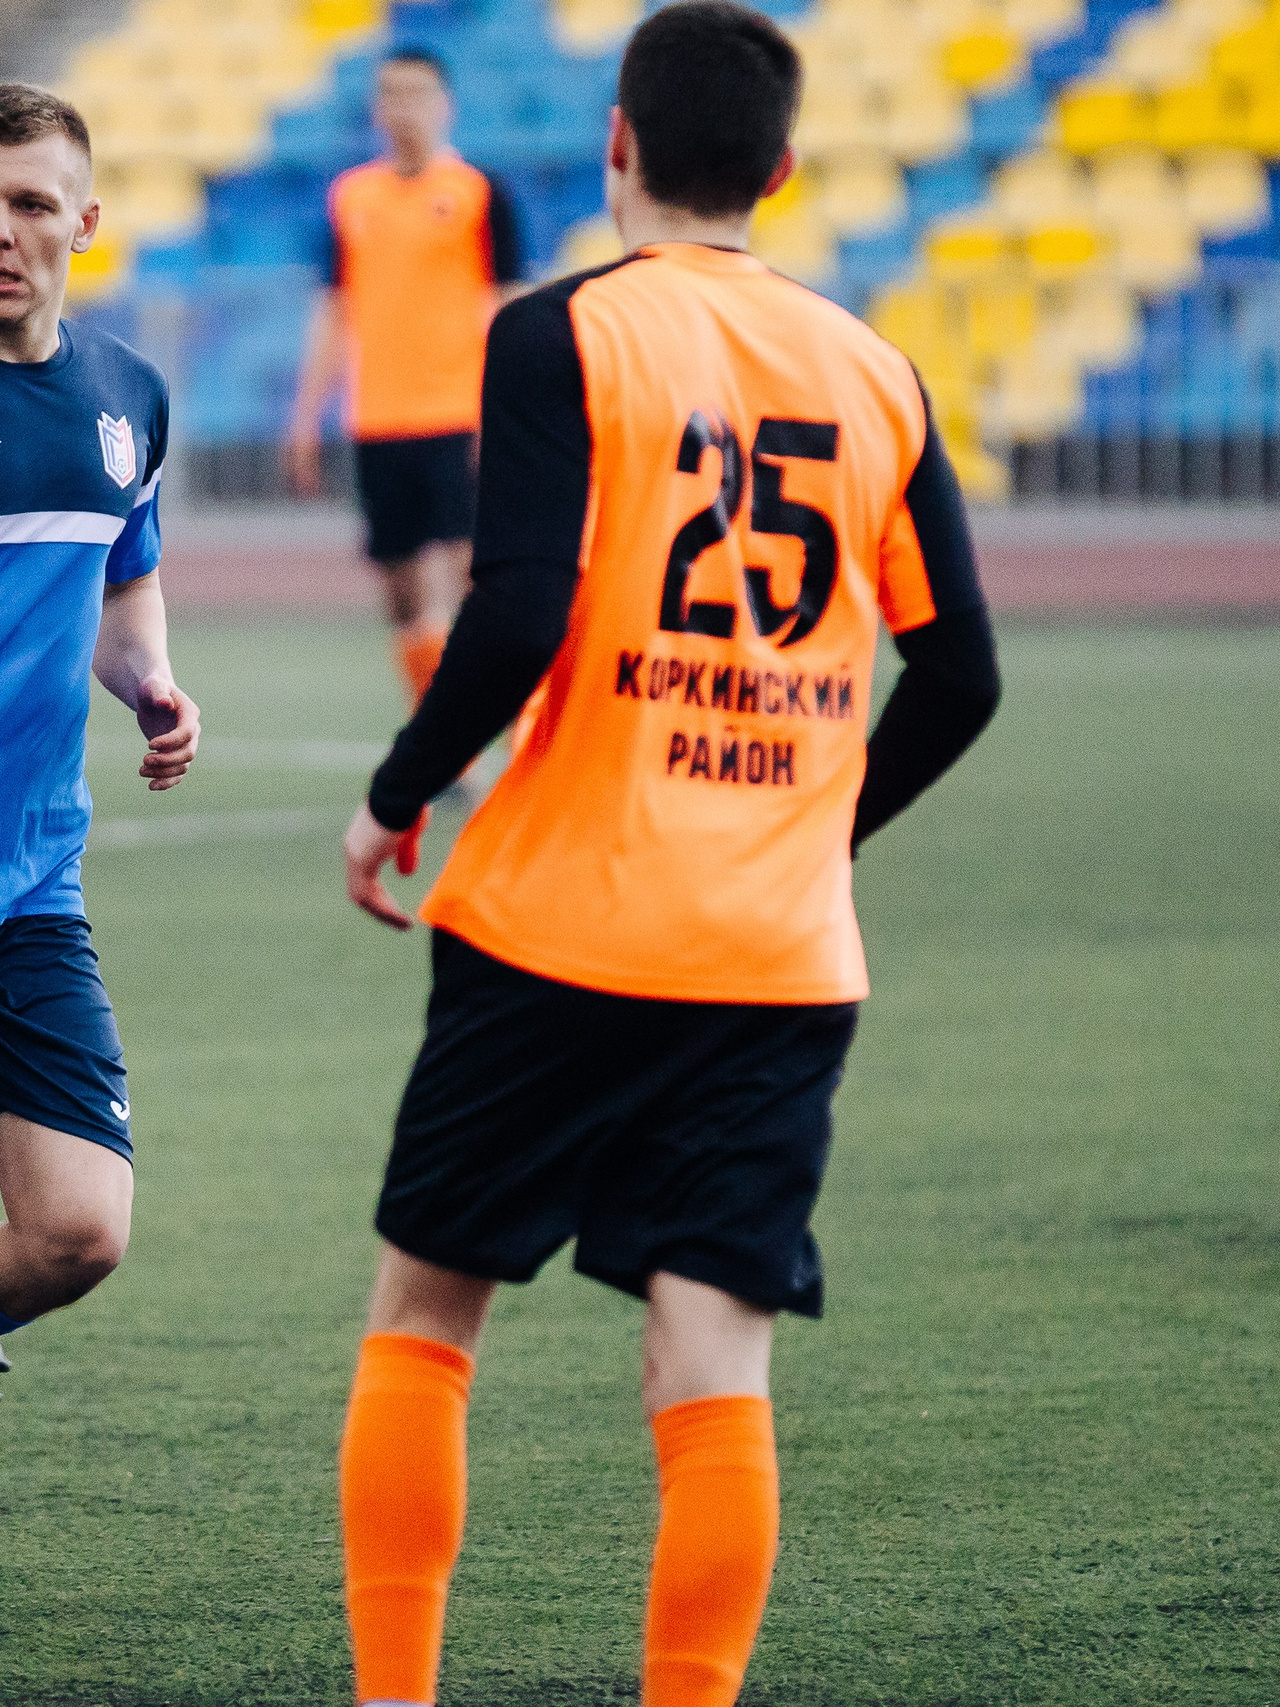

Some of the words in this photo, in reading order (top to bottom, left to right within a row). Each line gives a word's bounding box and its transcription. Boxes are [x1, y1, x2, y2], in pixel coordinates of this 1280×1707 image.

[658, 409, 840, 650] 25
[614, 649, 856, 720] КОРКИНСКИЙ
[666, 724, 797, 787] РАЙОН
